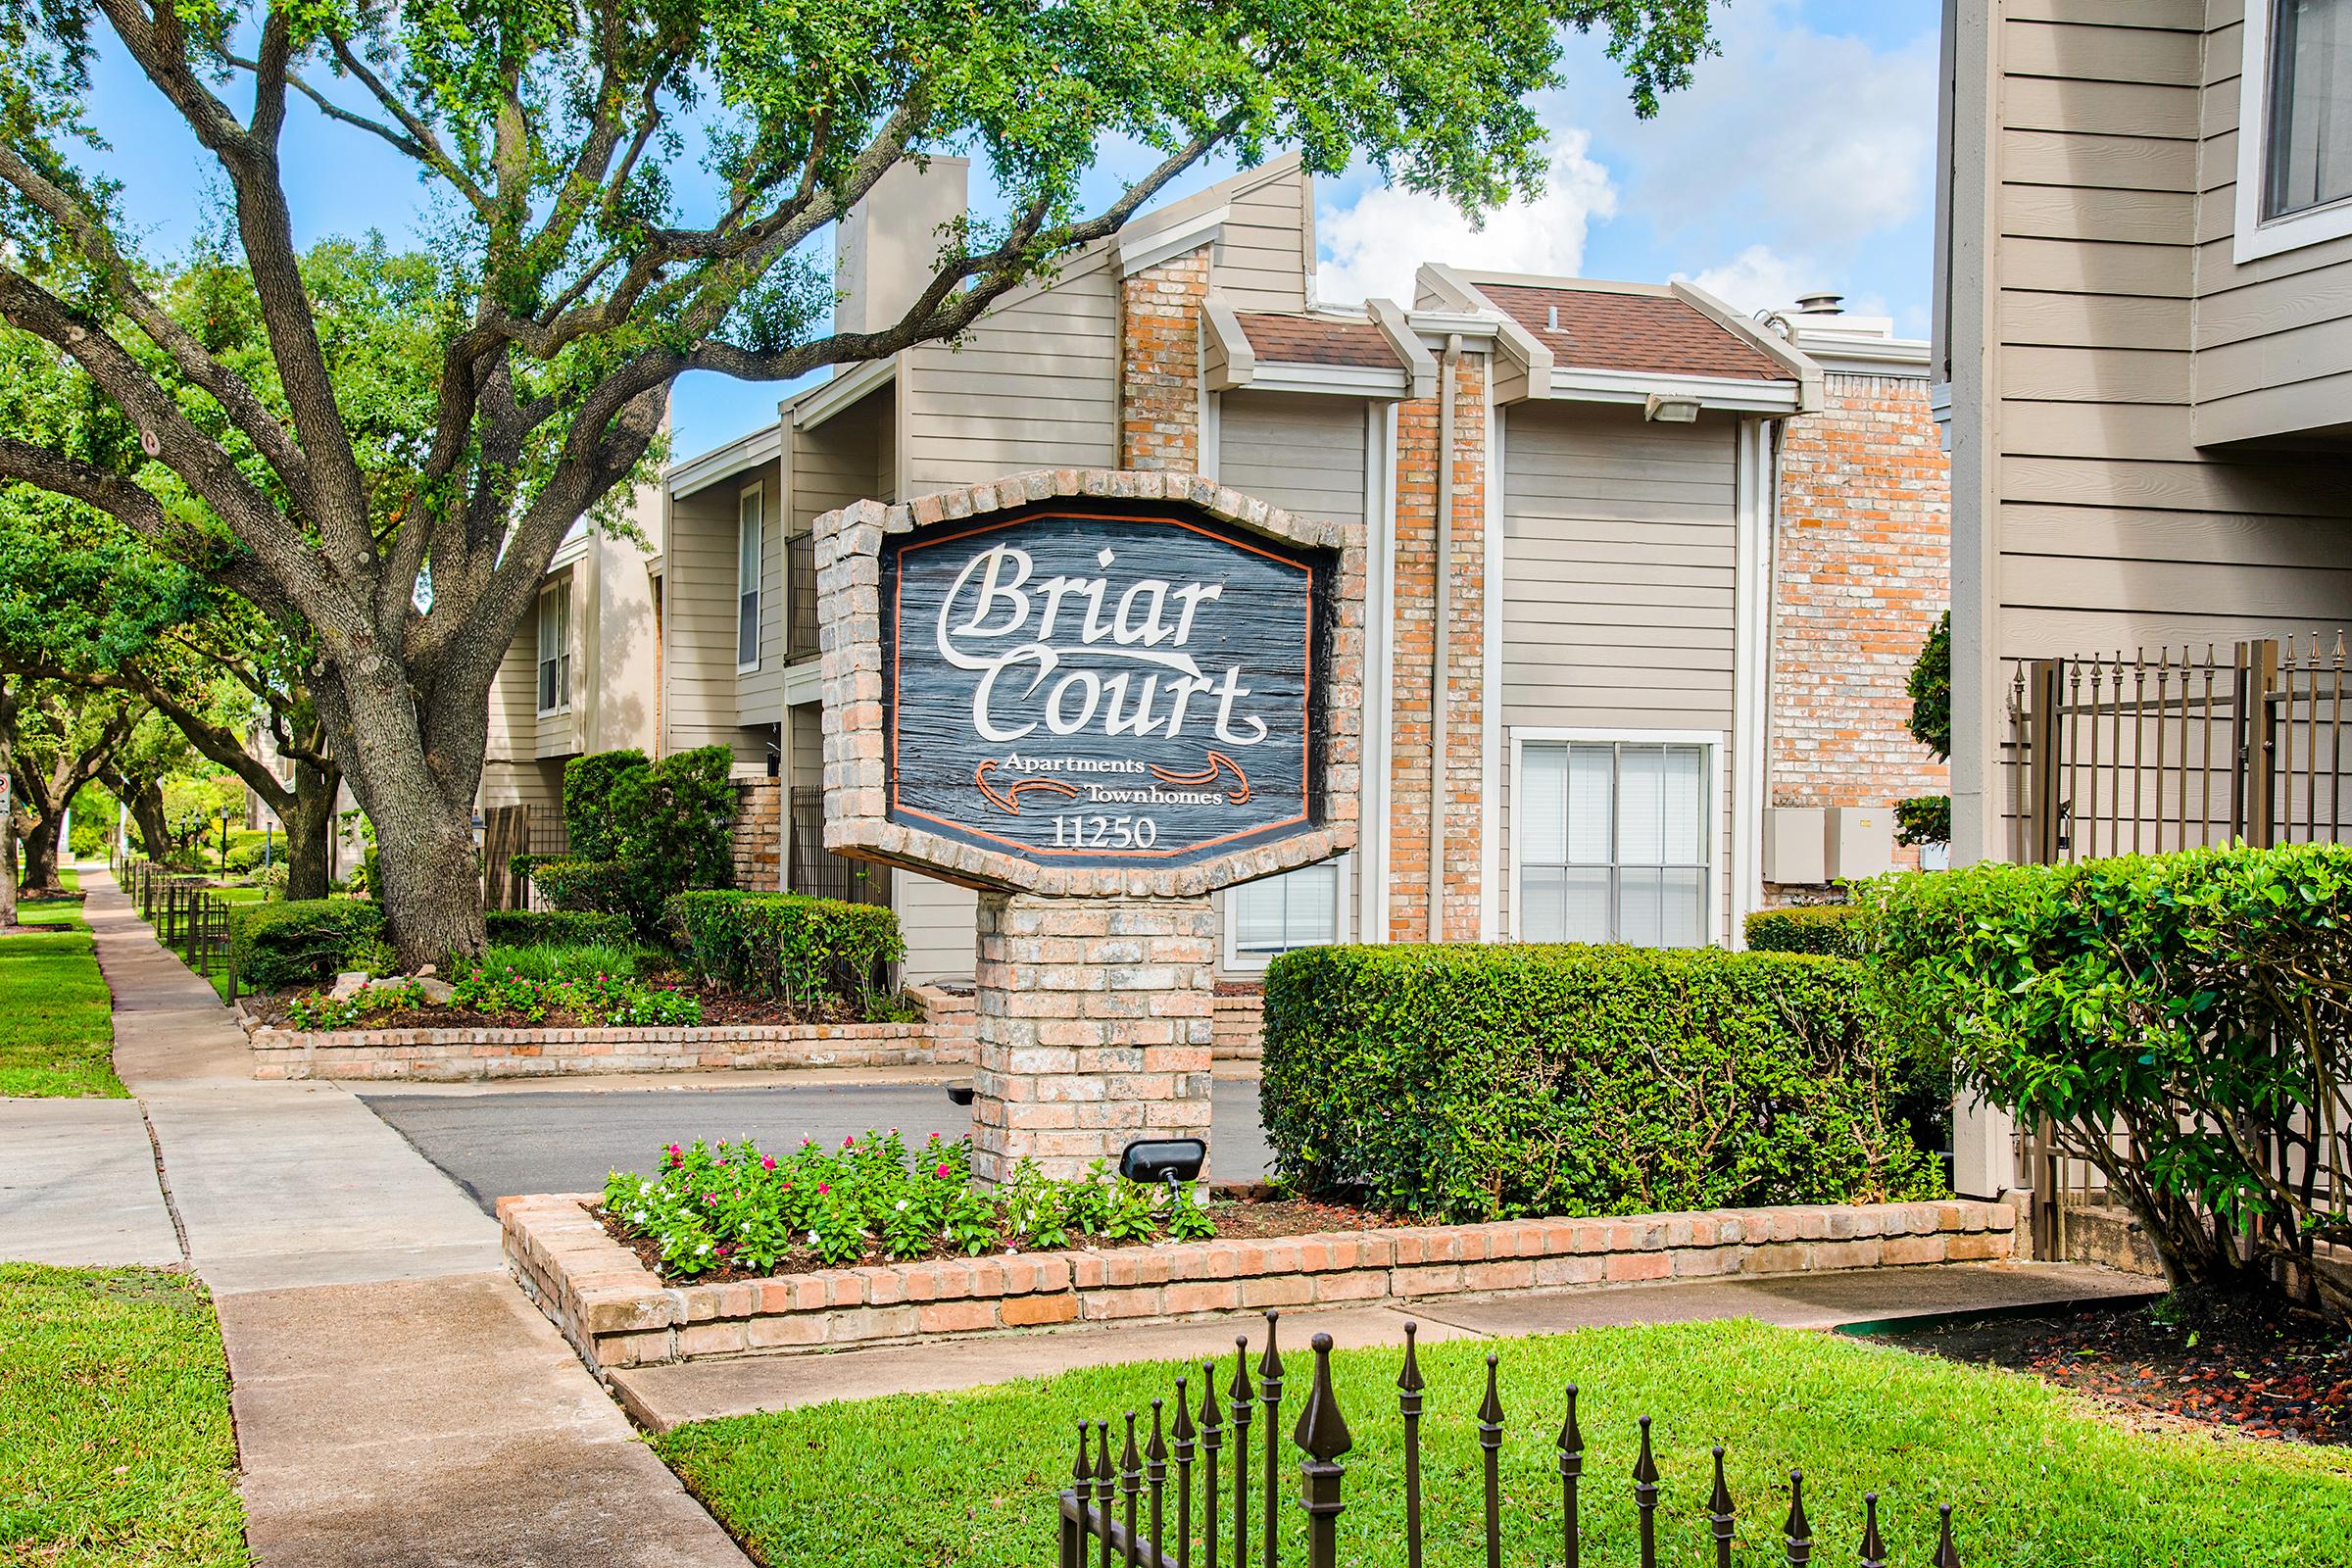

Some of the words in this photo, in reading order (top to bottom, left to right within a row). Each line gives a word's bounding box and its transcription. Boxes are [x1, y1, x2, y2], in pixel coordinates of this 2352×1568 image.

[937, 542, 1223, 669] Briar
[972, 644, 1268, 745] Court
[1003, 752, 1146, 774] Apartments
[1084, 785, 1223, 806] Townhomes
[1052, 815, 1157, 850] 11250
